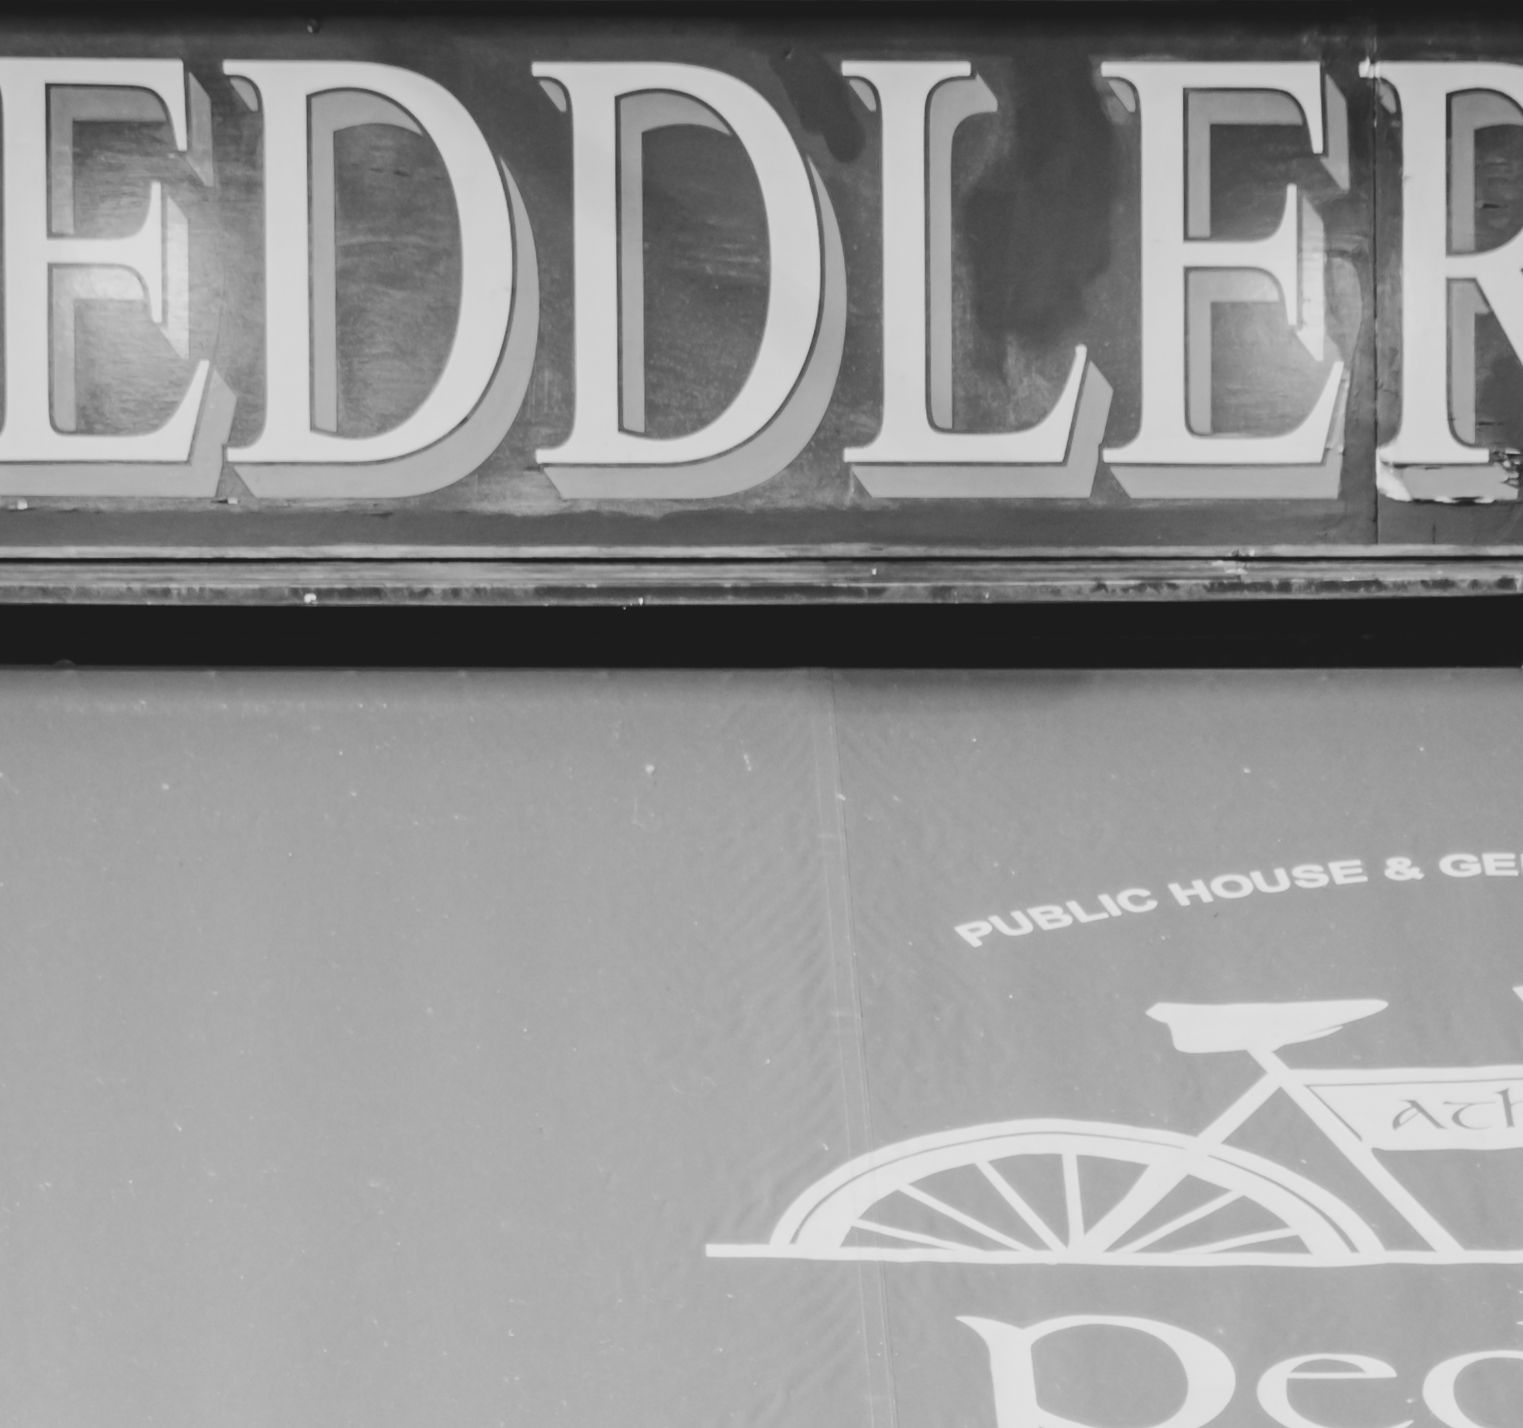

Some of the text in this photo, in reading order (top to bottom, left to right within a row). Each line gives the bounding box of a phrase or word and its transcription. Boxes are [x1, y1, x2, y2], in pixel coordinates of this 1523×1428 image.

[954, 888, 1158, 948] PUBLIC
[1168, 859, 1369, 906] HOUSE
[1383, 856, 1425, 881] &
